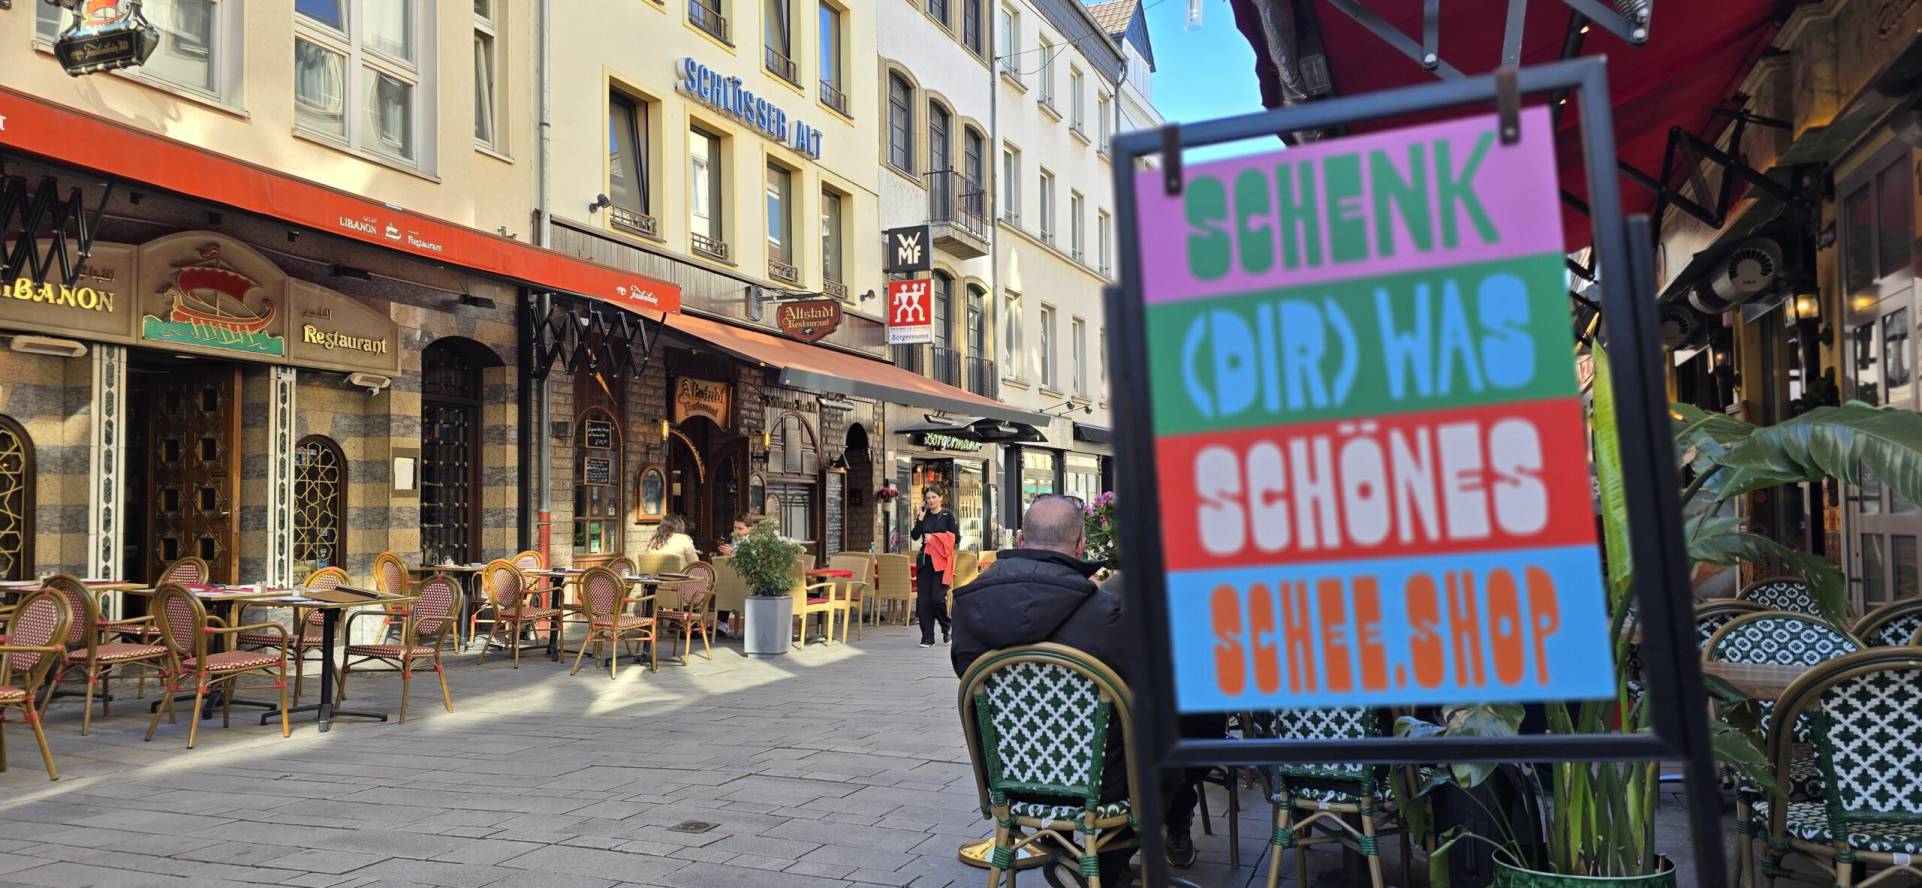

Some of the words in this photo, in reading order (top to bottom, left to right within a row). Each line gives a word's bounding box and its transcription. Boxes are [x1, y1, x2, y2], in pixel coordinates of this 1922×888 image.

[681, 57, 787, 143] SCHLÖSSER
[794, 119, 823, 160] ALT
[339, 216, 377, 235] LIBANON
[1184, 129, 1501, 282] SCHENK
[897, 232, 921, 266] WMF
[0, 277, 115, 313] IBANON
[783, 305, 833, 320] Altstadt
[303, 324, 388, 356] Restaurant
[1181, 295, 1360, 419] (DIR)
[1373, 272, 1536, 400] WAS
[1193, 418, 1549, 557] SCHÖNES
[1210, 565, 1561, 696] SCHEE.SHOP
